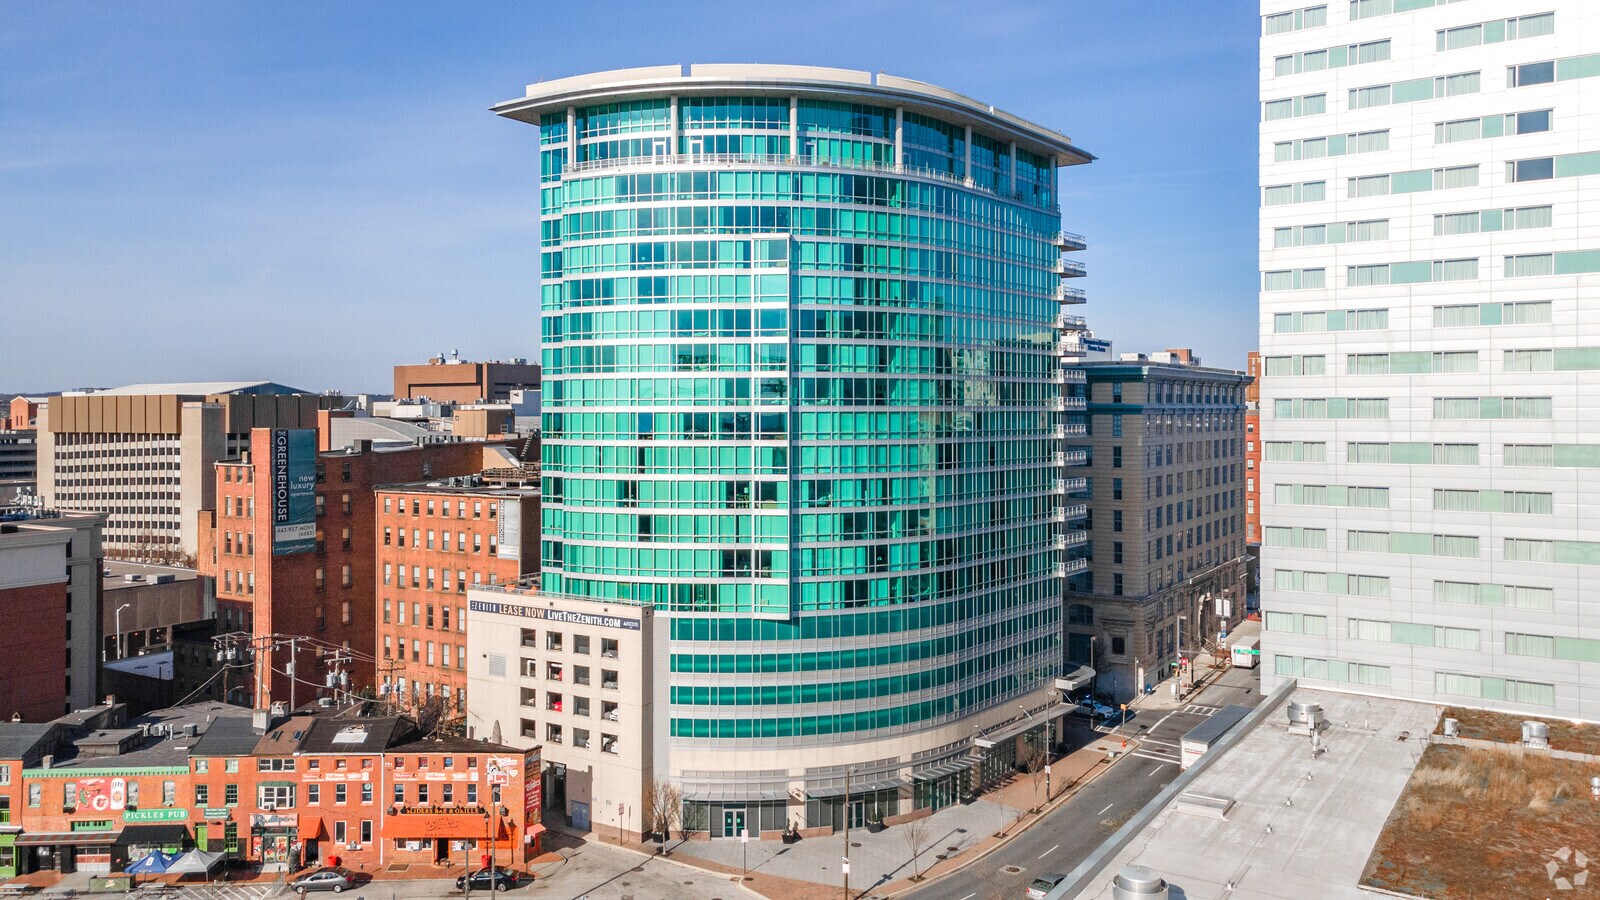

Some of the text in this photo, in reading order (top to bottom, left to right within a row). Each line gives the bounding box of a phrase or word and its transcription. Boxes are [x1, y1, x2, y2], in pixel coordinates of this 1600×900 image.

[277, 436, 287, 521] GREENEHOUSE
[290, 481, 315, 490] luxury
[499, 604, 523, 616] LEASE
[525, 607, 545, 619] NOW
[125, 810, 185, 819] PICKLES PUB
